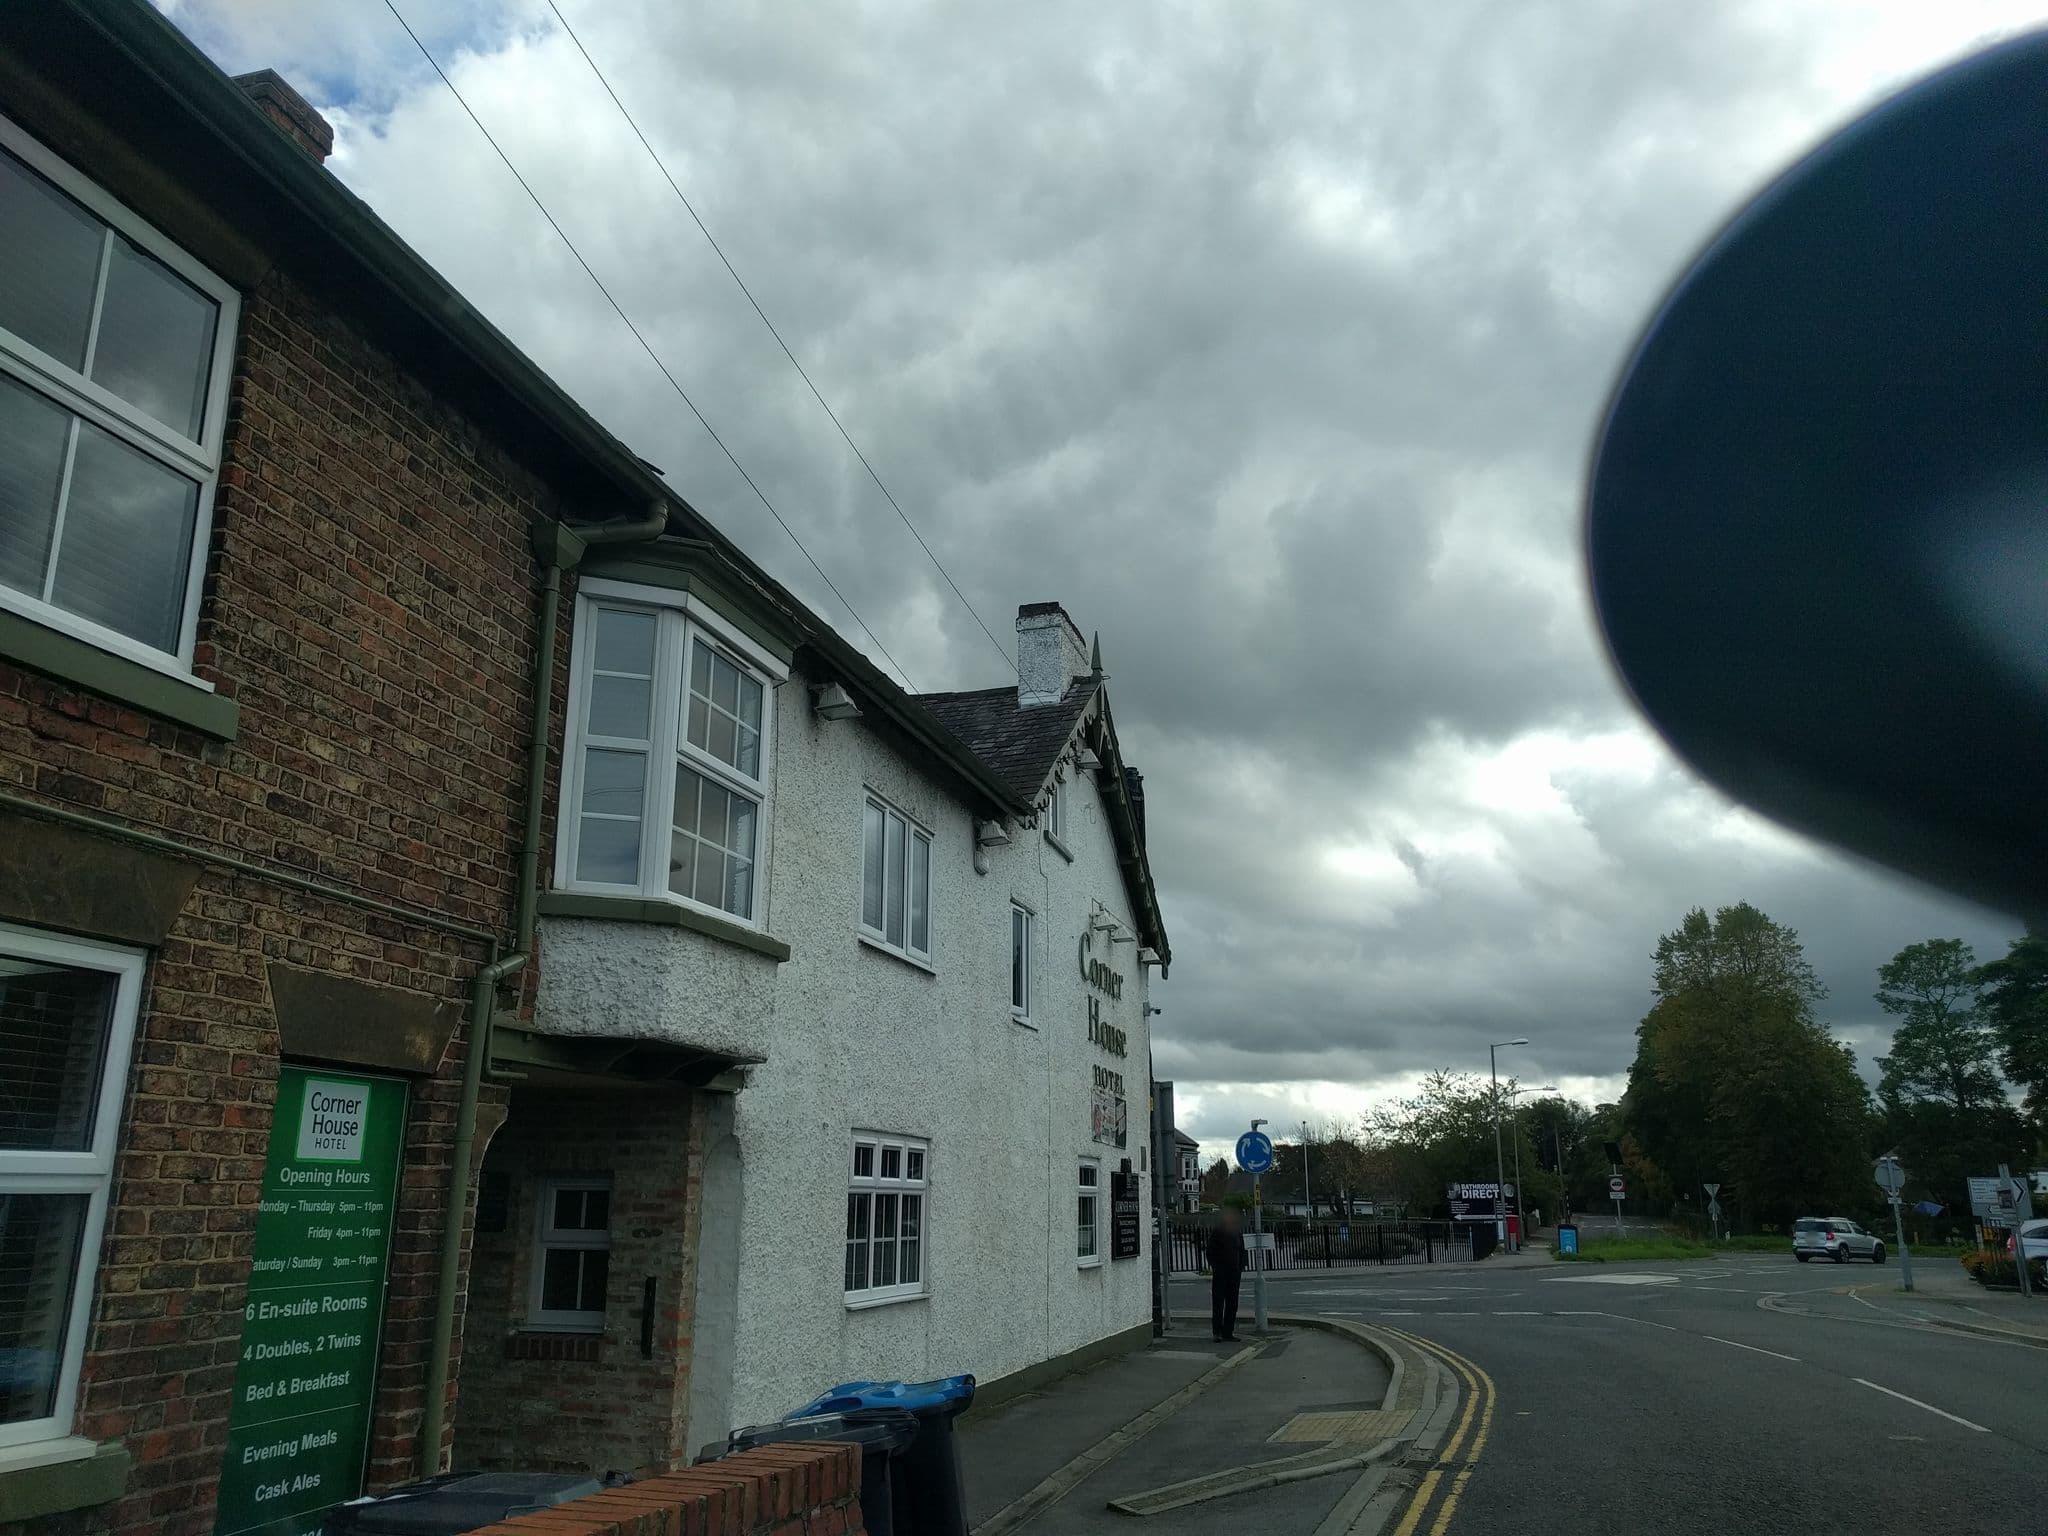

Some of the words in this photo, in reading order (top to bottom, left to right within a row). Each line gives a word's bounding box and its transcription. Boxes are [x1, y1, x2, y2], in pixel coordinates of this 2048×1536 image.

[1078, 931, 1123, 1001] Corner
[1088, 994, 1127, 1058] House
[1092, 1064, 1126, 1096] HOTEL
[311, 1091, 361, 1115] Corner
[312, 1114, 358, 1136] House
[315, 1137, 346, 1150] HOTEL
[280, 1167, 333, 1186] Opening
[335, 1169, 370, 1184] Hours
[299, 1200, 335, 1213] Thursday
[339, 1201, 356, 1212] 5pm
[364, 1201, 383, 1212] 11pm
[1462, 1190, 1499, 1199] DIRECT
[308, 1227, 333, 1241] Friday
[336, 1228, 353, 1238] 4pm
[361, 1227, 381, 1238] 11pm
[293, 1256, 323, 1270] Sunday
[333, 1256, 350, 1266] 3pm
[358, 1255, 378, 1265] 11pm
[245, 1304, 255, 1321] 6
[259, 1298, 318, 1319] En-suite
[322, 1295, 368, 1313] Rooms
[243, 1345, 252, 1361] 4
[256, 1339, 313, 1360] Doubles,
[316, 1338, 324, 1352] 2
[327, 1333, 362, 1350] Twins
[246, 1382, 274, 1402] Bed
[277, 1380, 287, 1397] &
[290, 1370, 351, 1394] Breakfast
[243, 1440, 298, 1465] Evening
[301, 1429, 338, 1451] Meals
[255, 1479, 289, 1503] Cask
[292, 1472, 321, 1492] Ales
